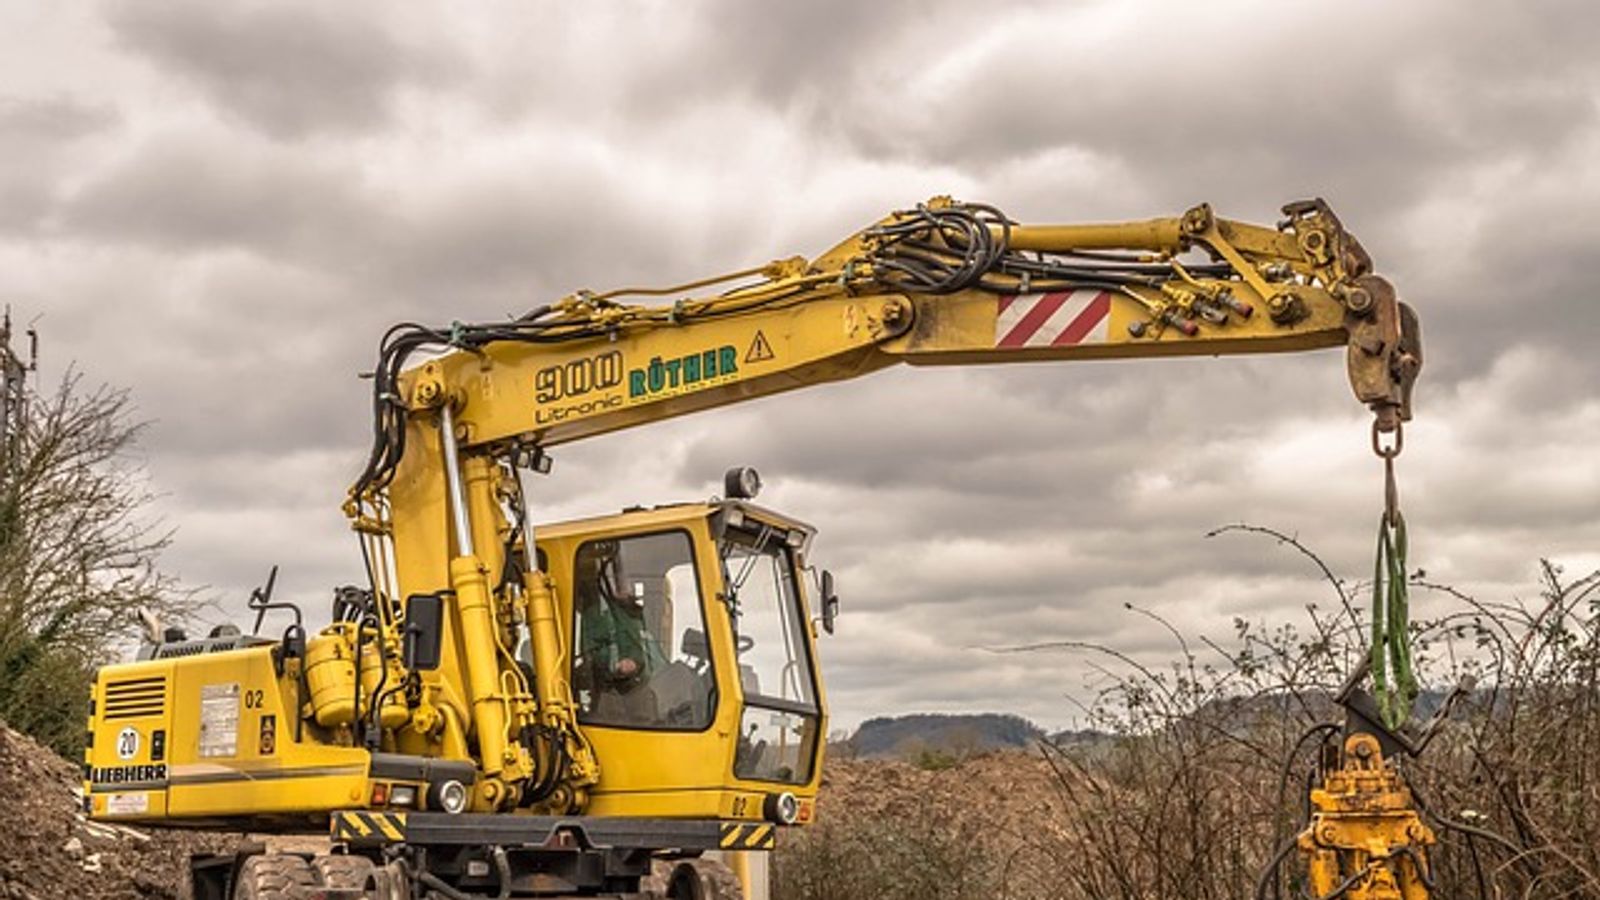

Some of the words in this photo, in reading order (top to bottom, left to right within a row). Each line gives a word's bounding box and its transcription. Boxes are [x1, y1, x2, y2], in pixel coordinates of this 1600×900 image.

[535, 350, 623, 404] 900
[629, 345, 738, 398] RÜTHER
[535, 394, 622, 423] Litronic
[245, 689, 264, 709] 02
[120, 732, 136, 756] 20
[92, 763, 166, 783] LIEBHERR
